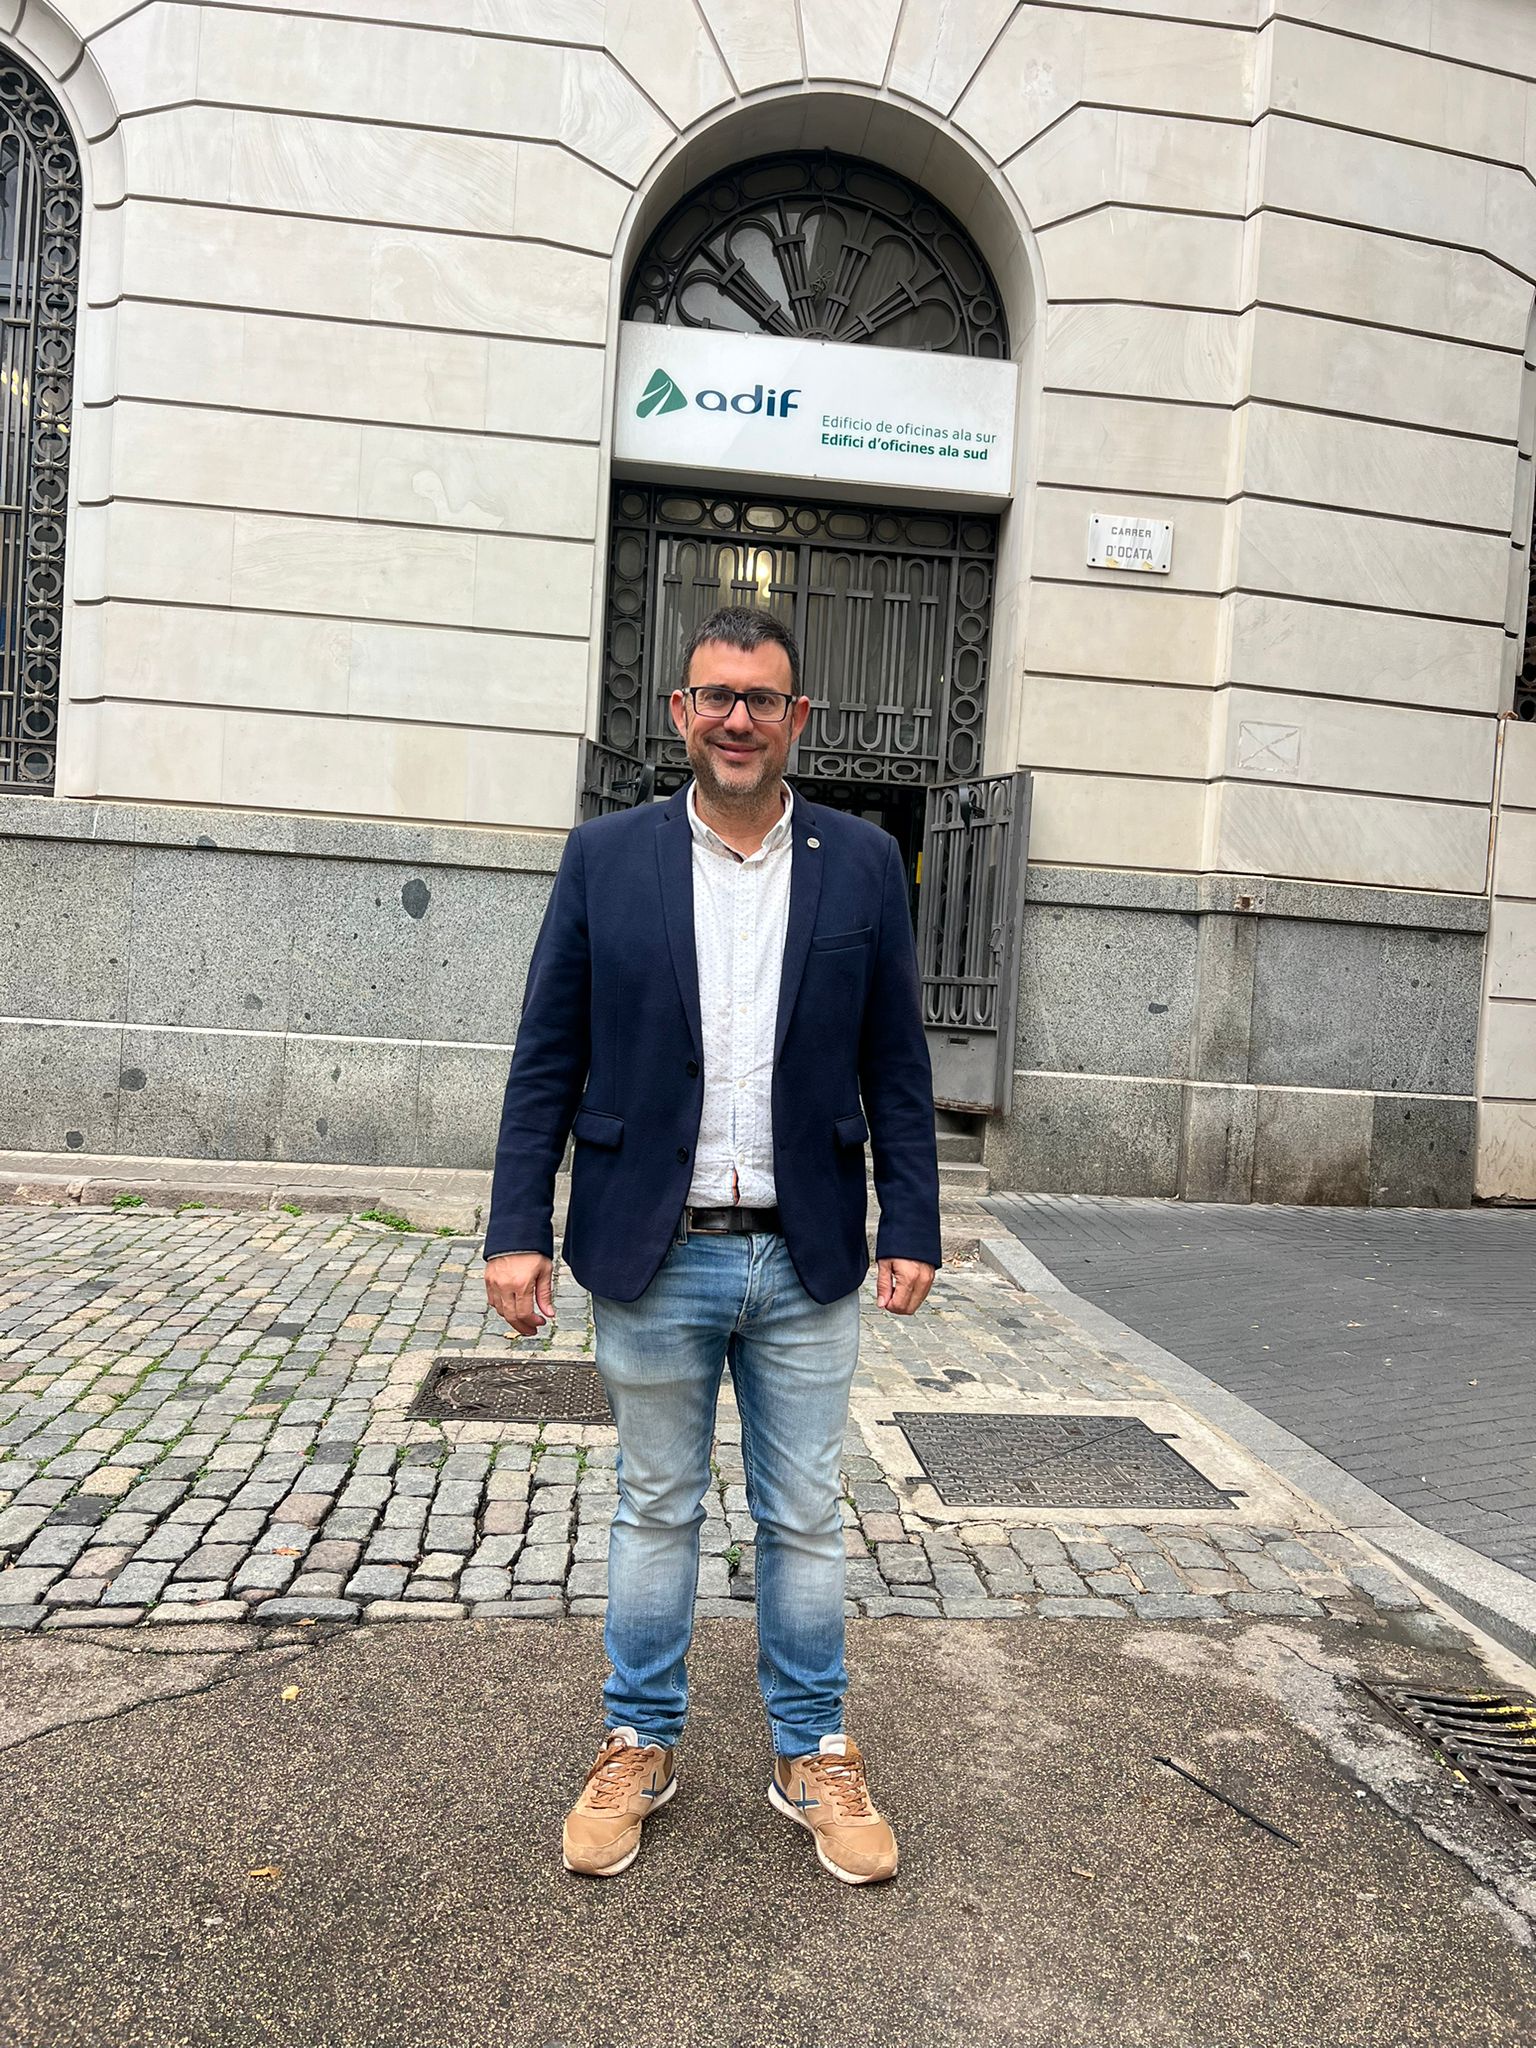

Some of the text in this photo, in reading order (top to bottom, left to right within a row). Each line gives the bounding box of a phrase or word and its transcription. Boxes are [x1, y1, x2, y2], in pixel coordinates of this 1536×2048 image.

[695, 384, 802, 418] adif
[822, 415, 998, 444] Edificio de oficinas ala sur
[821, 433, 988, 461] Edifici d'oficines ala sud
[1111, 526, 1152, 538] CARRER
[1106, 545, 1153, 560] D'OCATA
